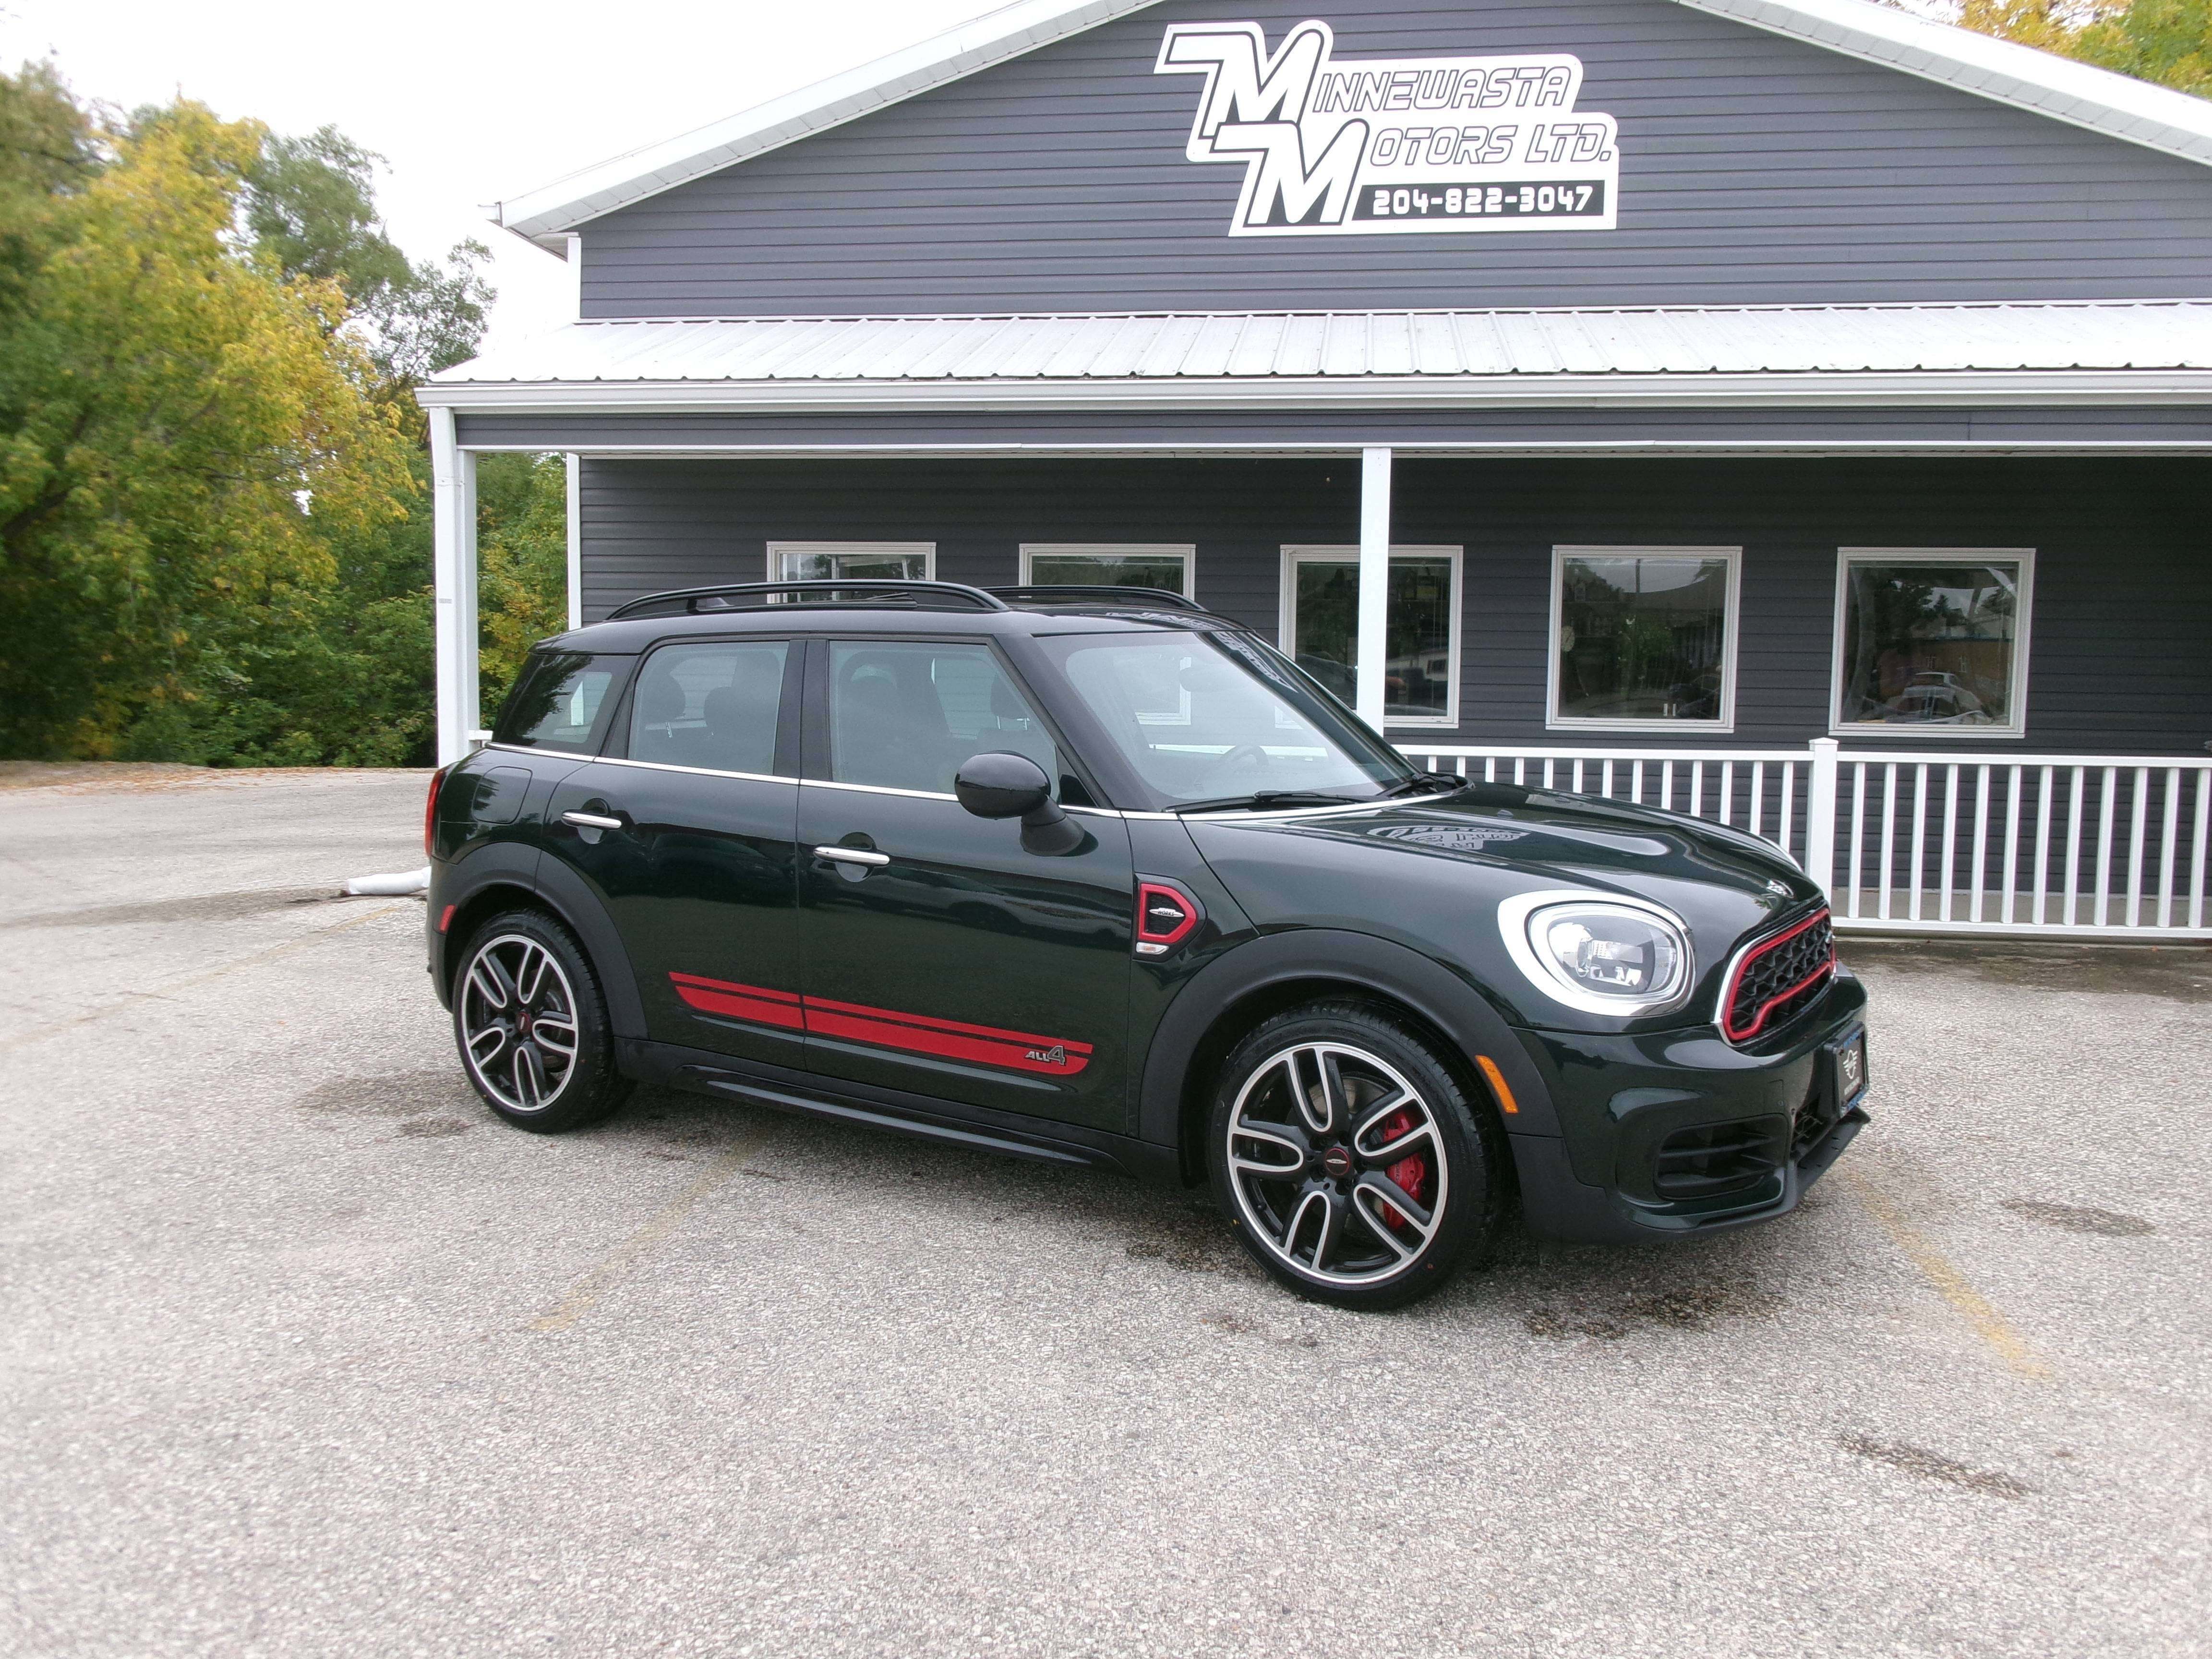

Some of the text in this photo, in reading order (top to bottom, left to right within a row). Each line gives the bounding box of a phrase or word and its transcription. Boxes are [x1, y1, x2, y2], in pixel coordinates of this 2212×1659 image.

[1164, 28, 1571, 139] MINNEWASTA
[1209, 118, 1612, 227] MOTORS LTD.
[1372, 185, 1593, 216] 204-822-3047
